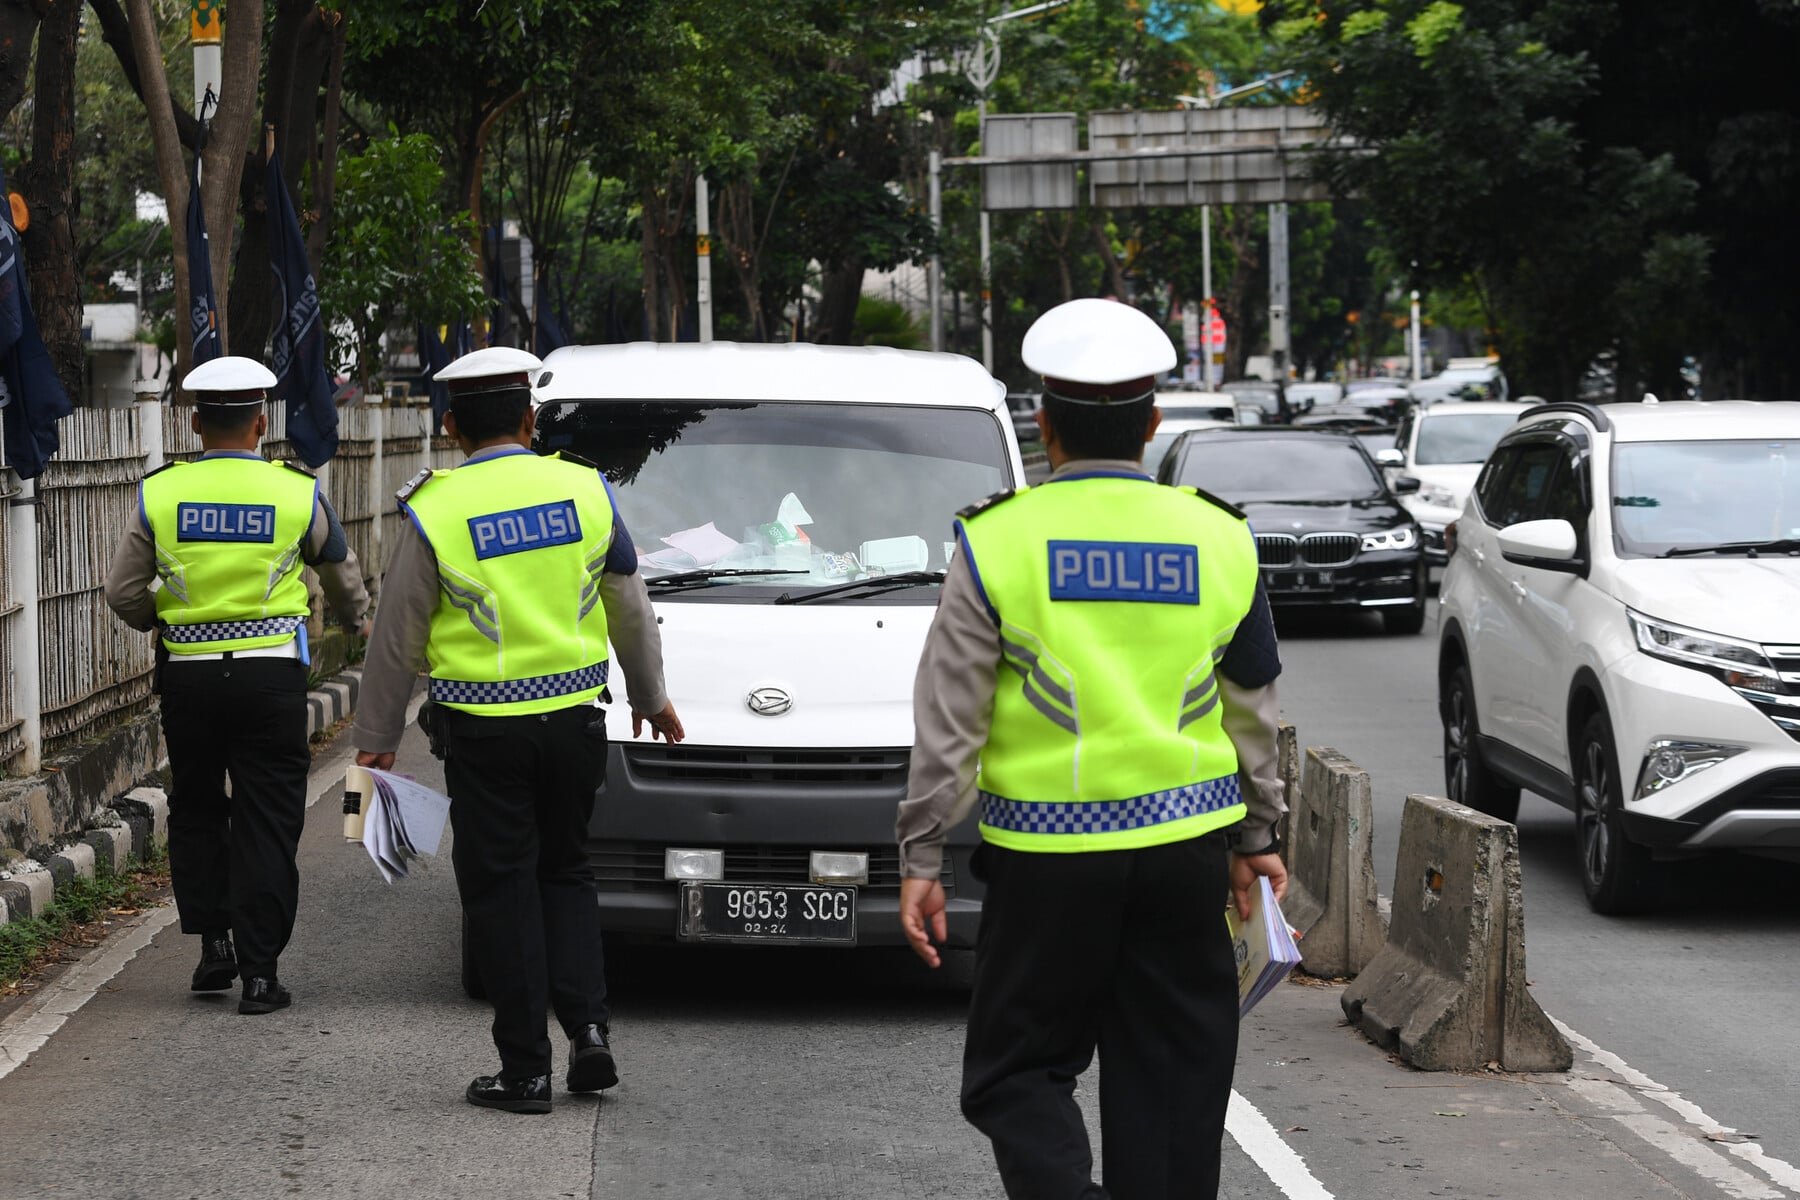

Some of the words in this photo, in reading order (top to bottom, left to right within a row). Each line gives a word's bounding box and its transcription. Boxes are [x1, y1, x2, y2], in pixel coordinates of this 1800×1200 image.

[182, 508, 272, 536] POLISI
[475, 506, 577, 552] POLISI
[1055, 548, 1195, 594] POLISI
[727, 889, 788, 920] 9853
[803, 891, 848, 920] SCG
